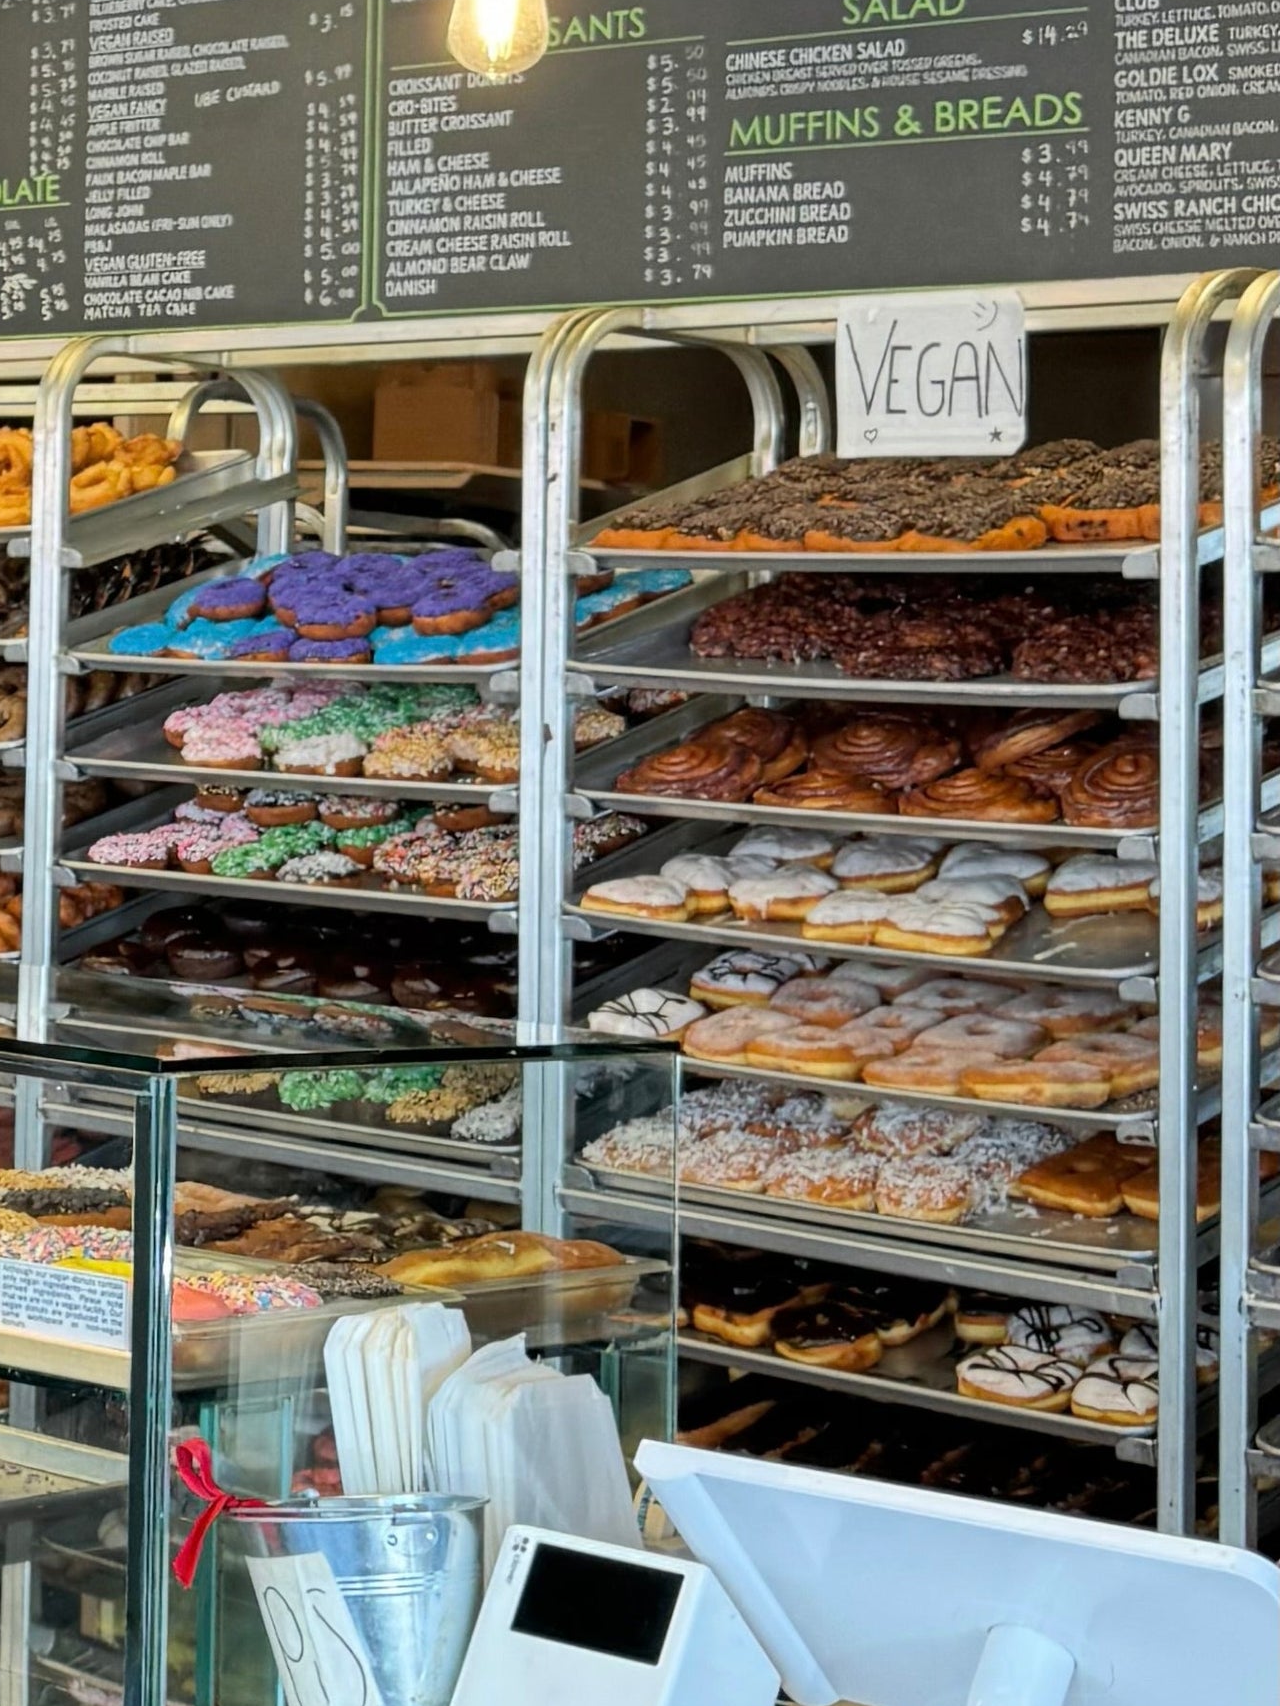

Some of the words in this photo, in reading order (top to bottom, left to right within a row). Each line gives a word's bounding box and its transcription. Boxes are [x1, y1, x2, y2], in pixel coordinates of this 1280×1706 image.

[134, 13, 160, 27] CAKE
[547, 7, 647, 47] SANTS
[90, 34, 131, 51] VEGAN
[132, 28, 174, 44] RAISED
[1114, 30, 1147, 49] THE
[1152, 23, 1220, 47] DELUXE
[726, 50, 785, 71] CHINESE
[790, 44, 852, 65] CHICKEN
[857, 39, 906, 60] SALAD
[390, 74, 462, 95] CROISSANT
[1114, 66, 1178, 88] GOLDIE
[1183, 63, 1219, 83] LOX
[1169, 87, 1194, 100] RED
[88, 102, 127, 120] VEGAN
[130, 98, 167, 116] FANCY
[389, 96, 456, 116] CRO-BITES
[1114, 106, 1173, 128] KENNY
[1178, 105, 1190, 123] G
[388, 118, 437, 136] BUTTER
[441, 110, 514, 132] CROISSANT
[729, 106, 880, 147] MUFFINS
[893, 104, 923, 136] &
[935, 91, 1083, 133] BREADS
[388, 138, 432, 157] FILLED
[1114, 145, 1176, 167] QUEEN
[1180, 142, 1232, 162] MARY
[388, 158, 420, 176] HAM
[424, 157, 434, 173] &
[437, 152, 489, 171] CHEESE
[725, 162, 793, 183] MUFFINS
[1114, 168, 1157, 183] CREAM
[463, 172, 495, 190] HAM
[498, 171, 508, 187] &
[510, 167, 562, 186] CHEESE
[388, 197, 439, 216] TURKEY
[442, 197, 452, 212] &
[455, 193, 505, 211] CHEESE
[724, 184, 789, 205] BANANA
[793, 181, 844, 201] BREAD
[723, 205, 796, 226] ZUCCHINI
[800, 202, 852, 223] BREAD
[1114, 200, 1168, 221] SWISS
[1174, 196, 1236, 217] RANCH
[387, 215, 460, 236] CINNAMON
[464, 214, 507, 230] RAISIN
[510, 212, 545, 228] ROLL
[386, 240, 433, 257] CREAM
[436, 235, 488, 253] CHEESE
[491, 232, 536, 250] RAISIN
[538, 230, 571, 246] ROLL
[723, 227, 793, 248] PUMPKIN
[797, 225, 848, 245] BREAD
[85, 256, 124, 272] VEGAN
[386, 257, 446, 277] ALMOND
[450, 255, 486, 273] BEAR
[490, 253, 532, 270] CLAW
[386, 279, 436, 297] DANISH
[84, 304, 131, 320] MATCHA
[138, 303, 161, 316] TEA
[845, 320, 1022, 417] VEGAN
